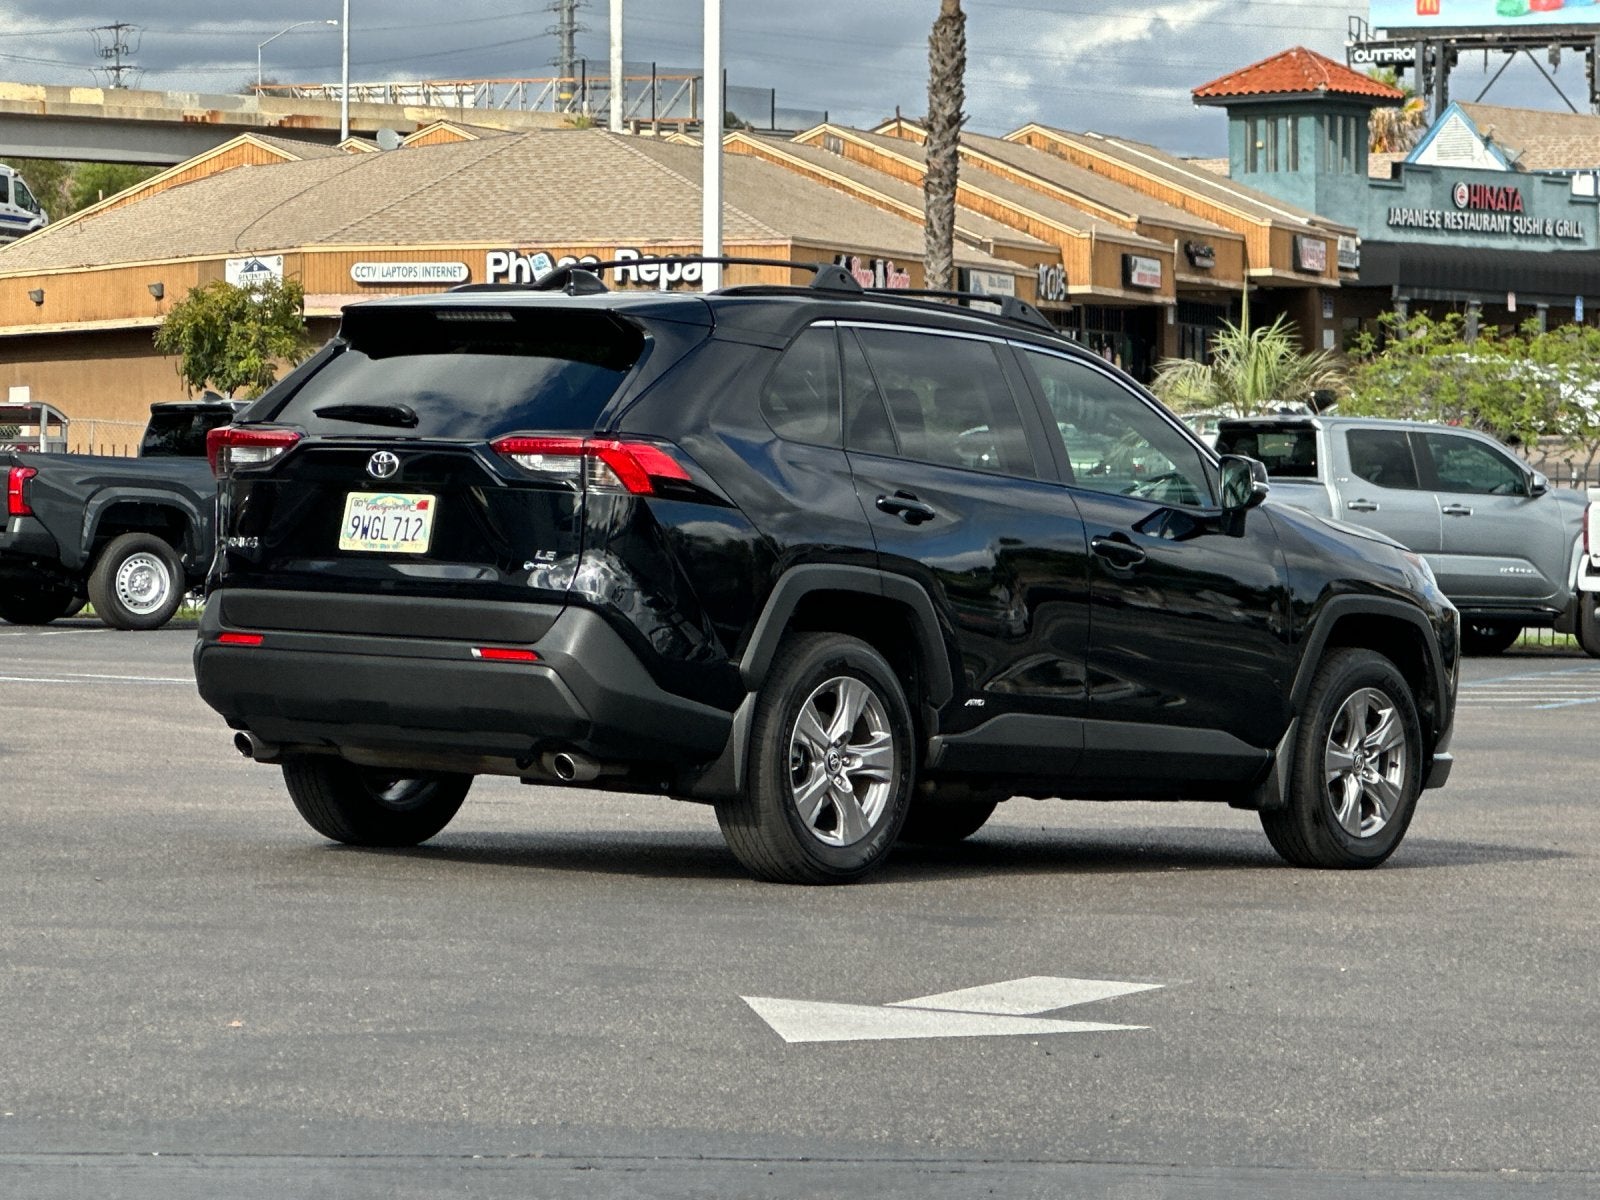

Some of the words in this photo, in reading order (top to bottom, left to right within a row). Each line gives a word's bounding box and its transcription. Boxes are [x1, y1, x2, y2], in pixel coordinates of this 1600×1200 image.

[1354, 47, 1416, 62] OUTFRO
[1468, 184, 1523, 212] HINATA
[1389, 208, 1441, 228] JAPANESE
[1444, 212, 1510, 232] RESTAURANT
[1513, 216, 1542, 235] SUSHI
[1545, 220, 1553, 235] &
[1556, 219, 1583, 238] GRILL
[355, 266, 376, 278] CCTV
[382, 266, 418, 278] LAPTOPS
[422, 266, 462, 278] INTERNET
[614, 249, 703, 291] Repa
[351, 515, 423, 541] 9WGL712
[535, 550, 556, 561] LE
